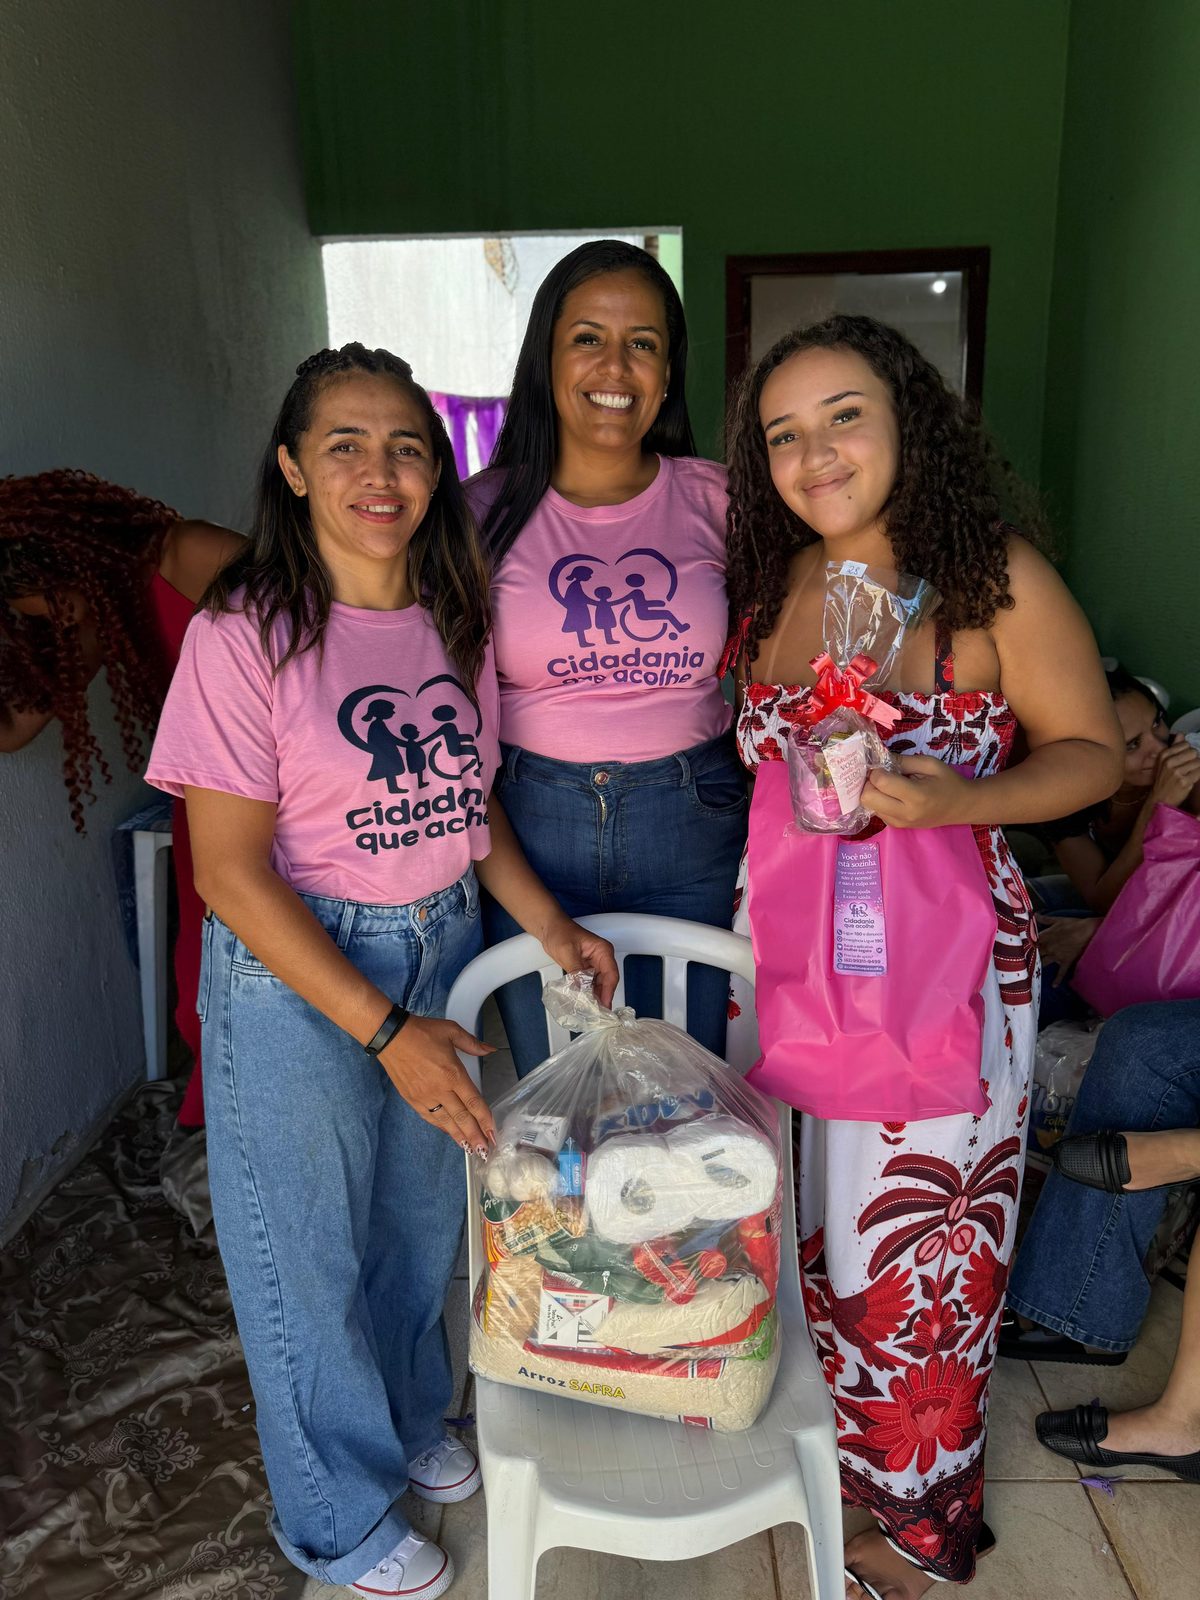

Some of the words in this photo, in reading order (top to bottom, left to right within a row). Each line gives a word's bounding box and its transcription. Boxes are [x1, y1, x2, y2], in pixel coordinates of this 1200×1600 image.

[547, 645, 705, 677] Cidadania
[612, 669, 692, 686] acolhe
[356, 829, 419, 855] que
[518, 1366, 566, 1387] Arroz
[569, 1379, 626, 1399] SAFRA
